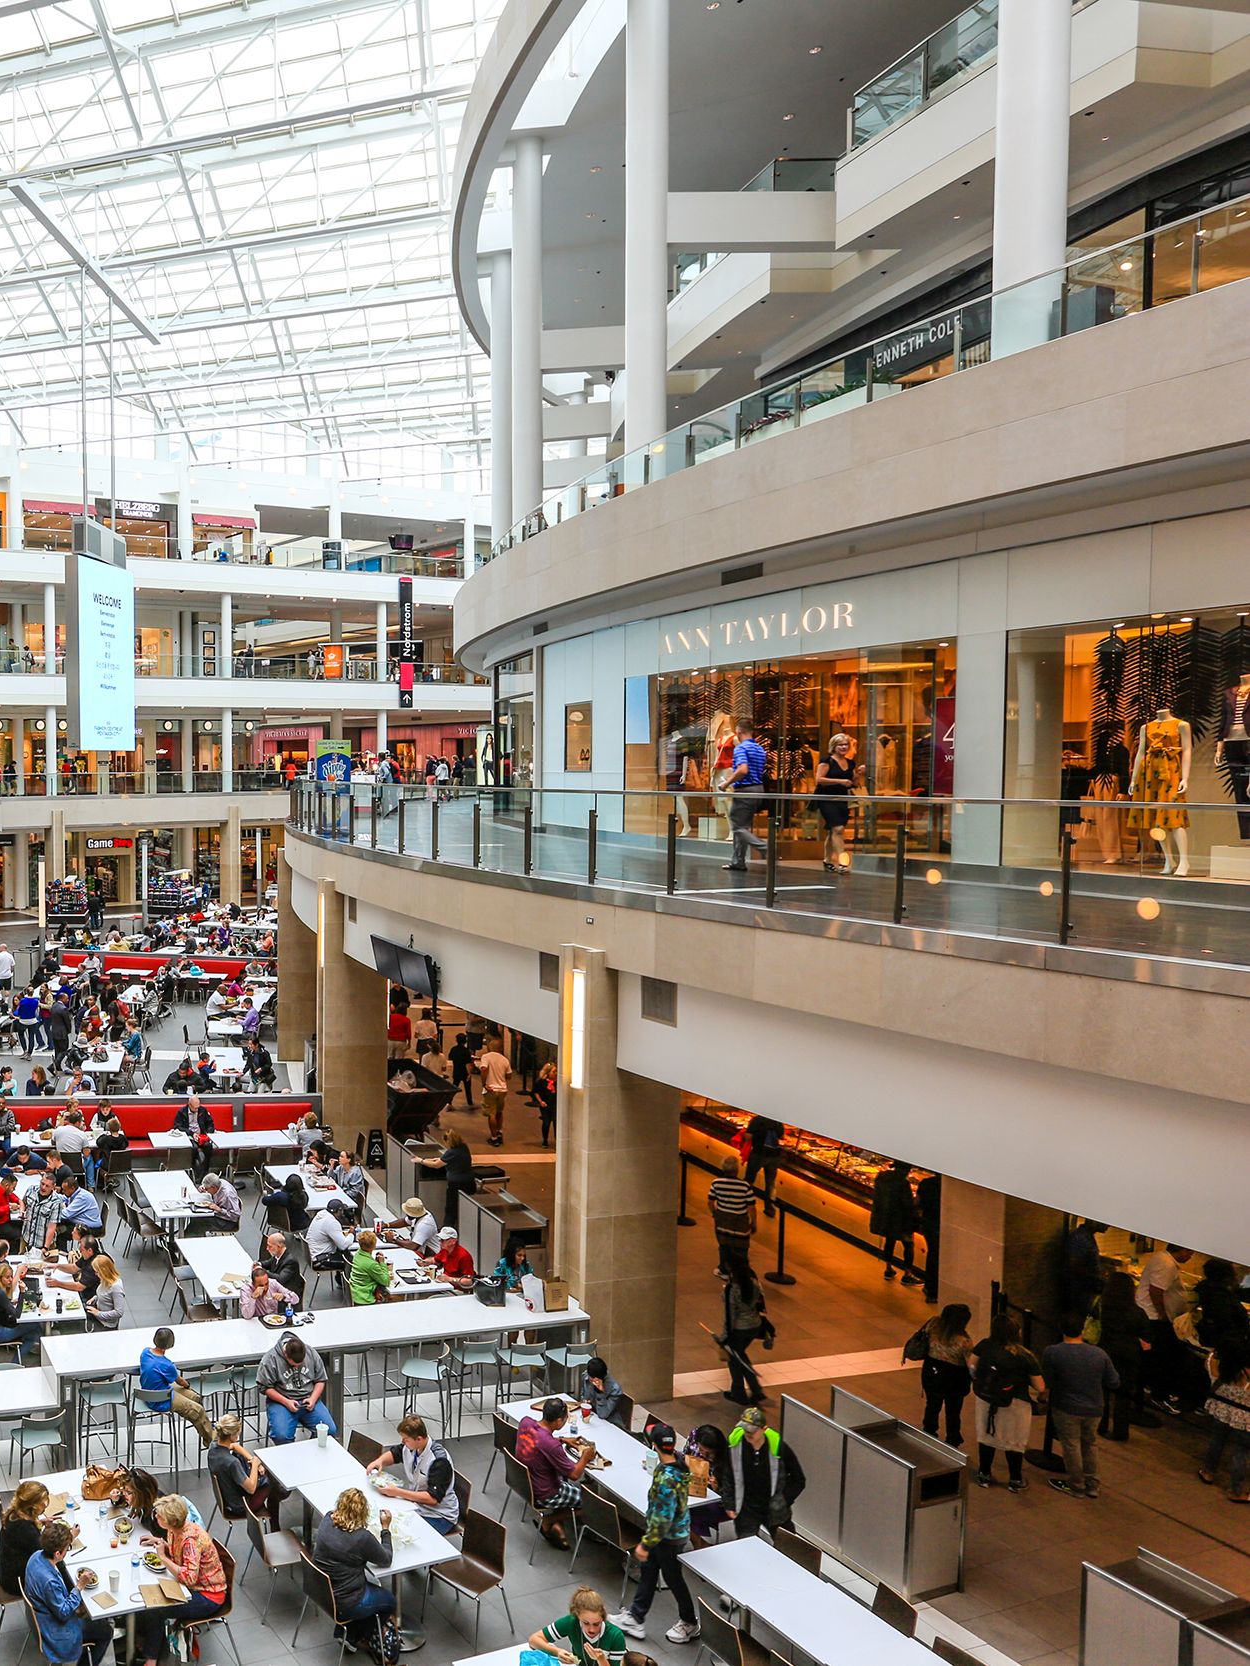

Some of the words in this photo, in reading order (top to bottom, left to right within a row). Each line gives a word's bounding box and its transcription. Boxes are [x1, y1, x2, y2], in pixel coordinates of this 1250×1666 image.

[873, 333, 924, 369] ENNETH
[929, 315, 961, 344] COLE
[115, 501, 160, 513] HELZBERG
[122, 510, 153, 518] DIAMONDS
[93, 592, 121, 609] WELCOME
[403, 602, 411, 657] Nordstrom
[661, 627, 710, 655] ANN
[720, 602, 855, 646] TAYLOR
